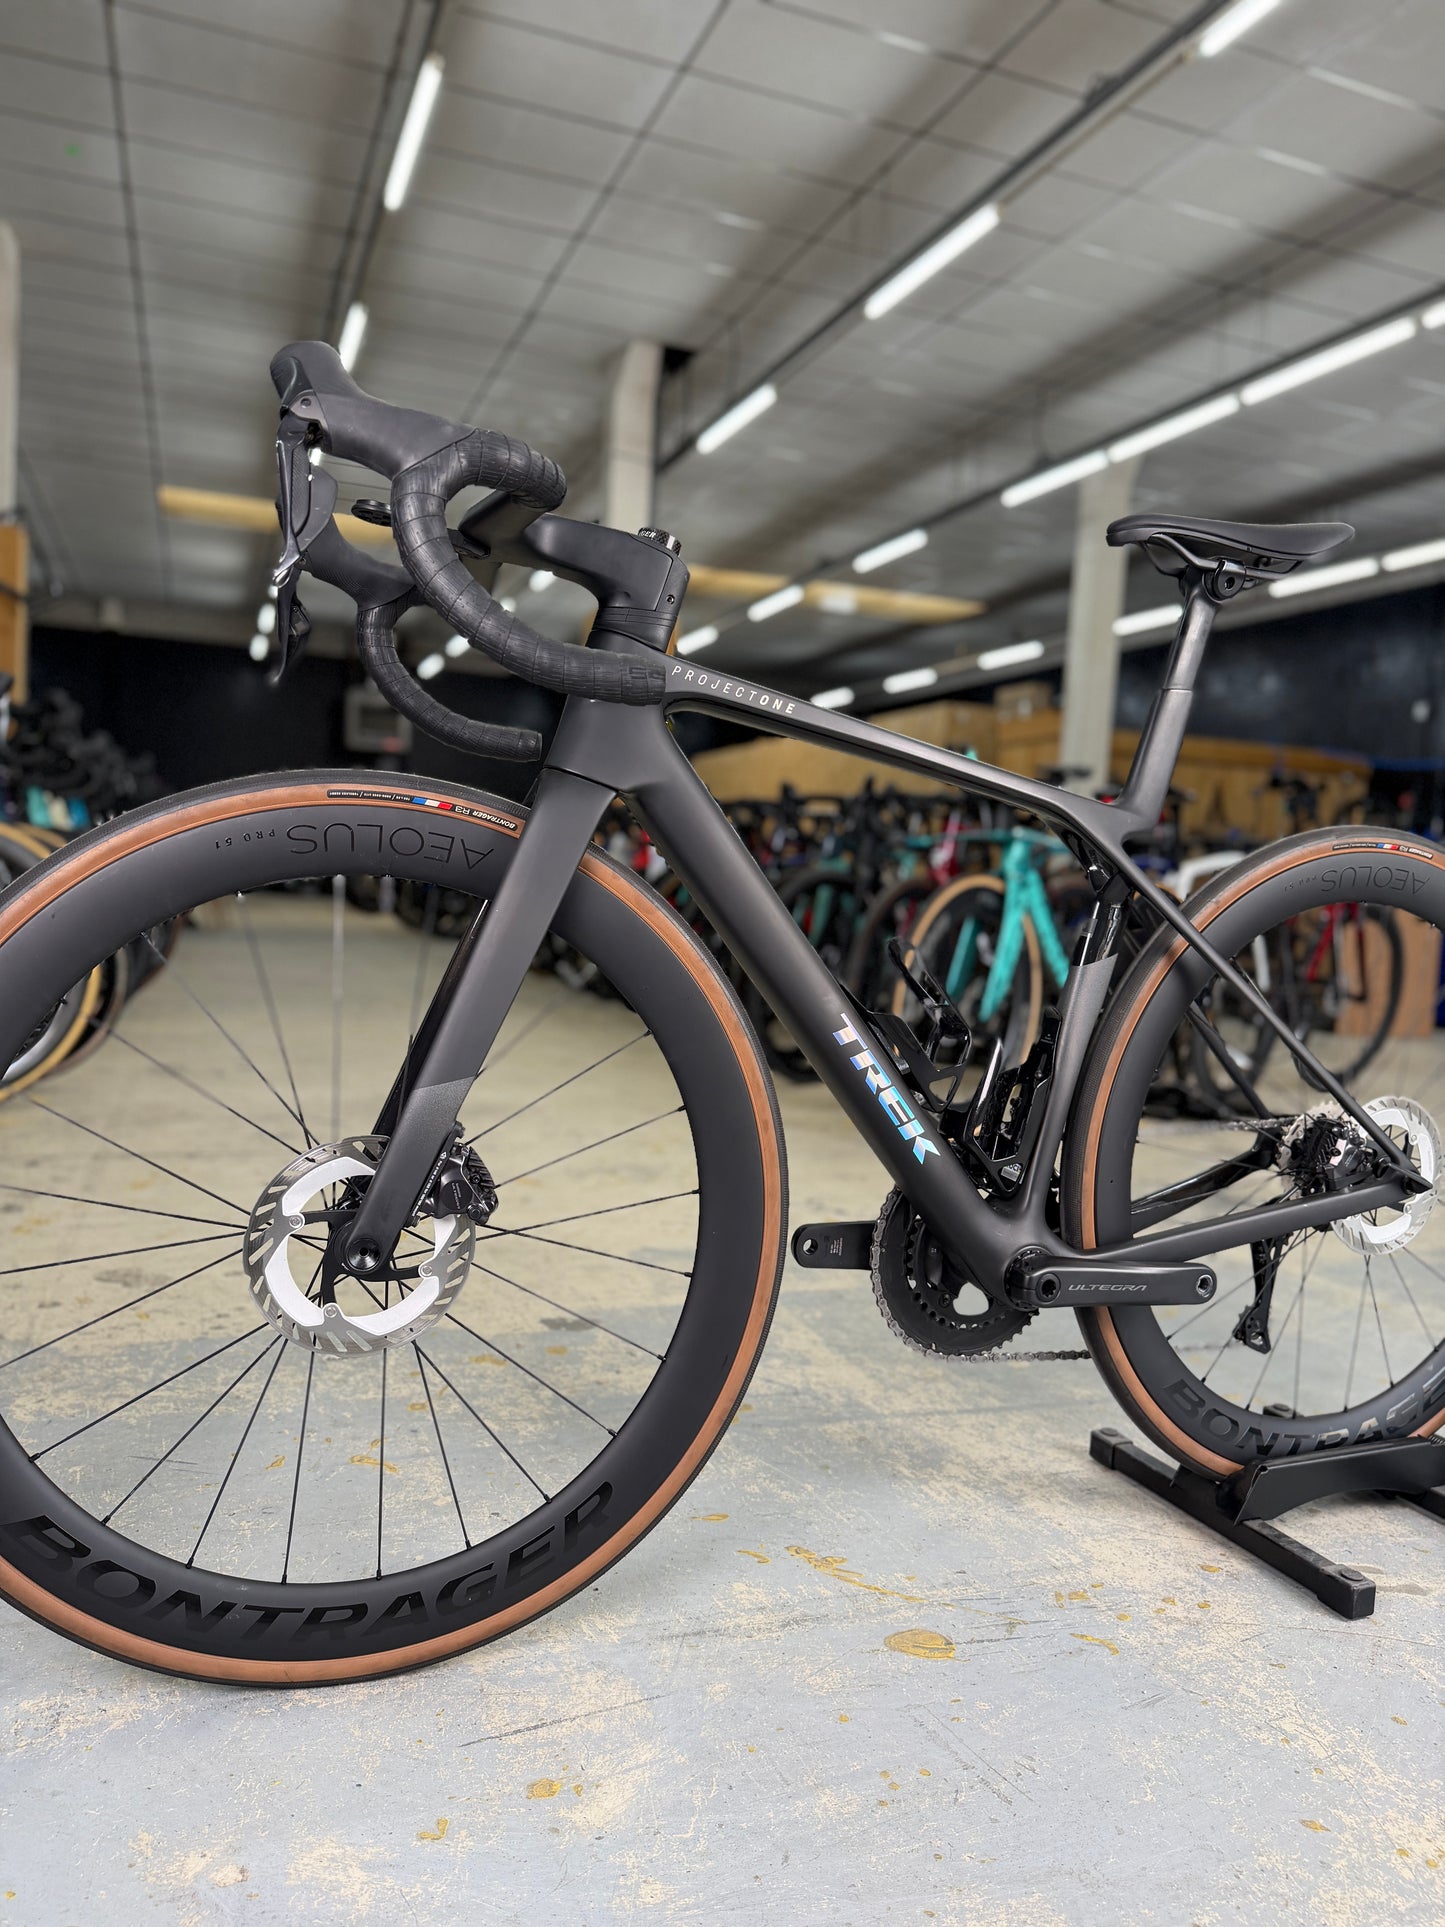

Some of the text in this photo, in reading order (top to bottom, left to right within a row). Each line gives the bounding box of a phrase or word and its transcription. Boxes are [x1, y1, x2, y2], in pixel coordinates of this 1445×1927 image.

[454, 805, 516, 829] BONTRAGER R3
[214, 822, 495, 870] AEOLUS PRO 51
[1321, 866, 1430, 894] AEOLUS
[832, 1012, 941, 1165] TREK
[1067, 1283, 1148, 1292] ULTEGRA
[0, 1480, 614, 1643] BONTRAGER
